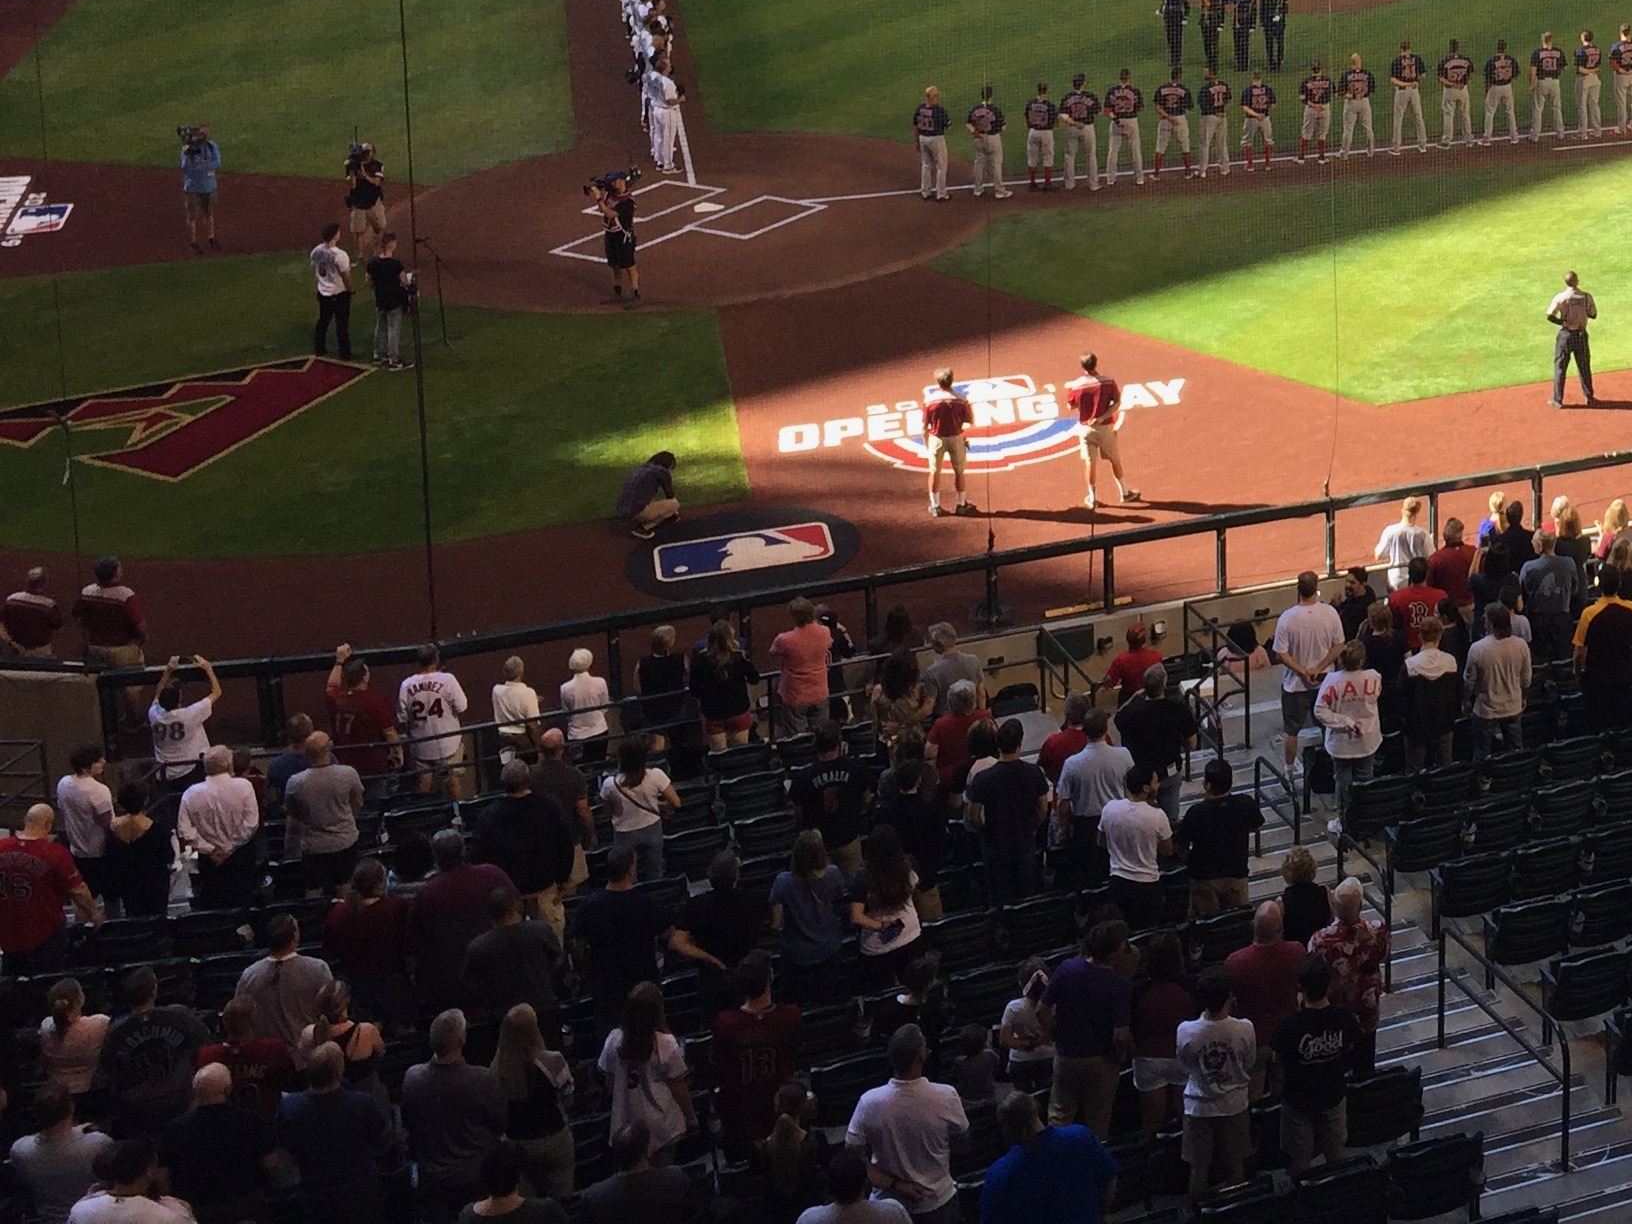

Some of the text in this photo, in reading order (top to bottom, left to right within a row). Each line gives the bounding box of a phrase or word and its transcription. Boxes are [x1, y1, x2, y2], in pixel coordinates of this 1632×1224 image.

[407, 680, 445, 698] RAMIREZ
[410, 698, 445, 722] 24
[155, 721, 185, 743] 98
